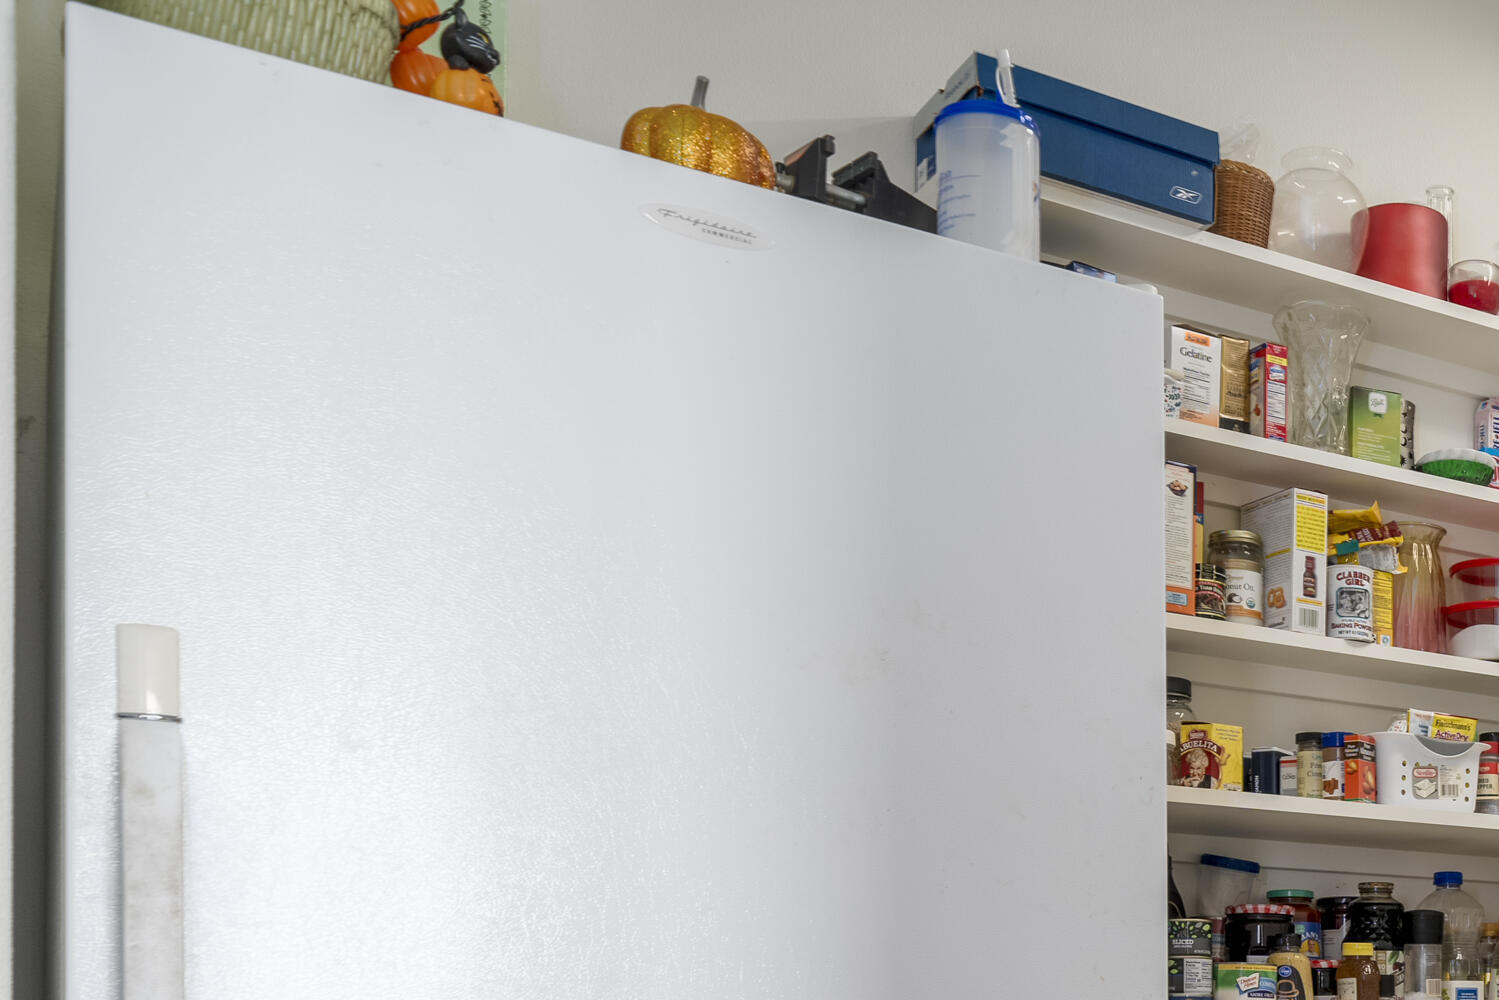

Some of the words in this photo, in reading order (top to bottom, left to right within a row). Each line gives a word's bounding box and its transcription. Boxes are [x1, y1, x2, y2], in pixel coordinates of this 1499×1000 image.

[657, 207, 758, 239] Frigidaire
[1180, 346, 1213, 362] Gelatine
[1336, 571, 1371, 584] CLABBER
[1345, 578, 1365, 587] GIRL
